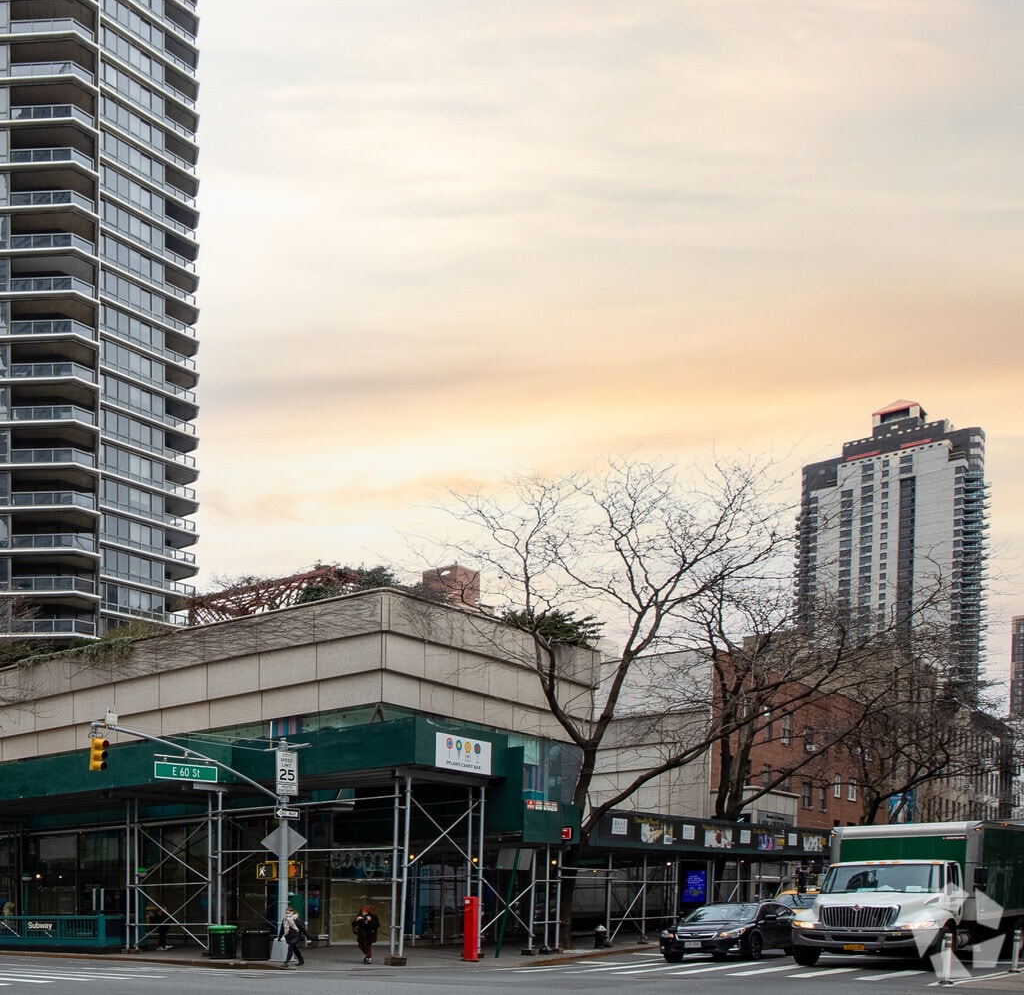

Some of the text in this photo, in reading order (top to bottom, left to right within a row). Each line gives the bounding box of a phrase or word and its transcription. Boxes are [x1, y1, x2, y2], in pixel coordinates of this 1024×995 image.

[172, 766, 200, 778] E 60 St
[279, 768, 295, 781] 25
[27, 921, 53, 931] Subway
